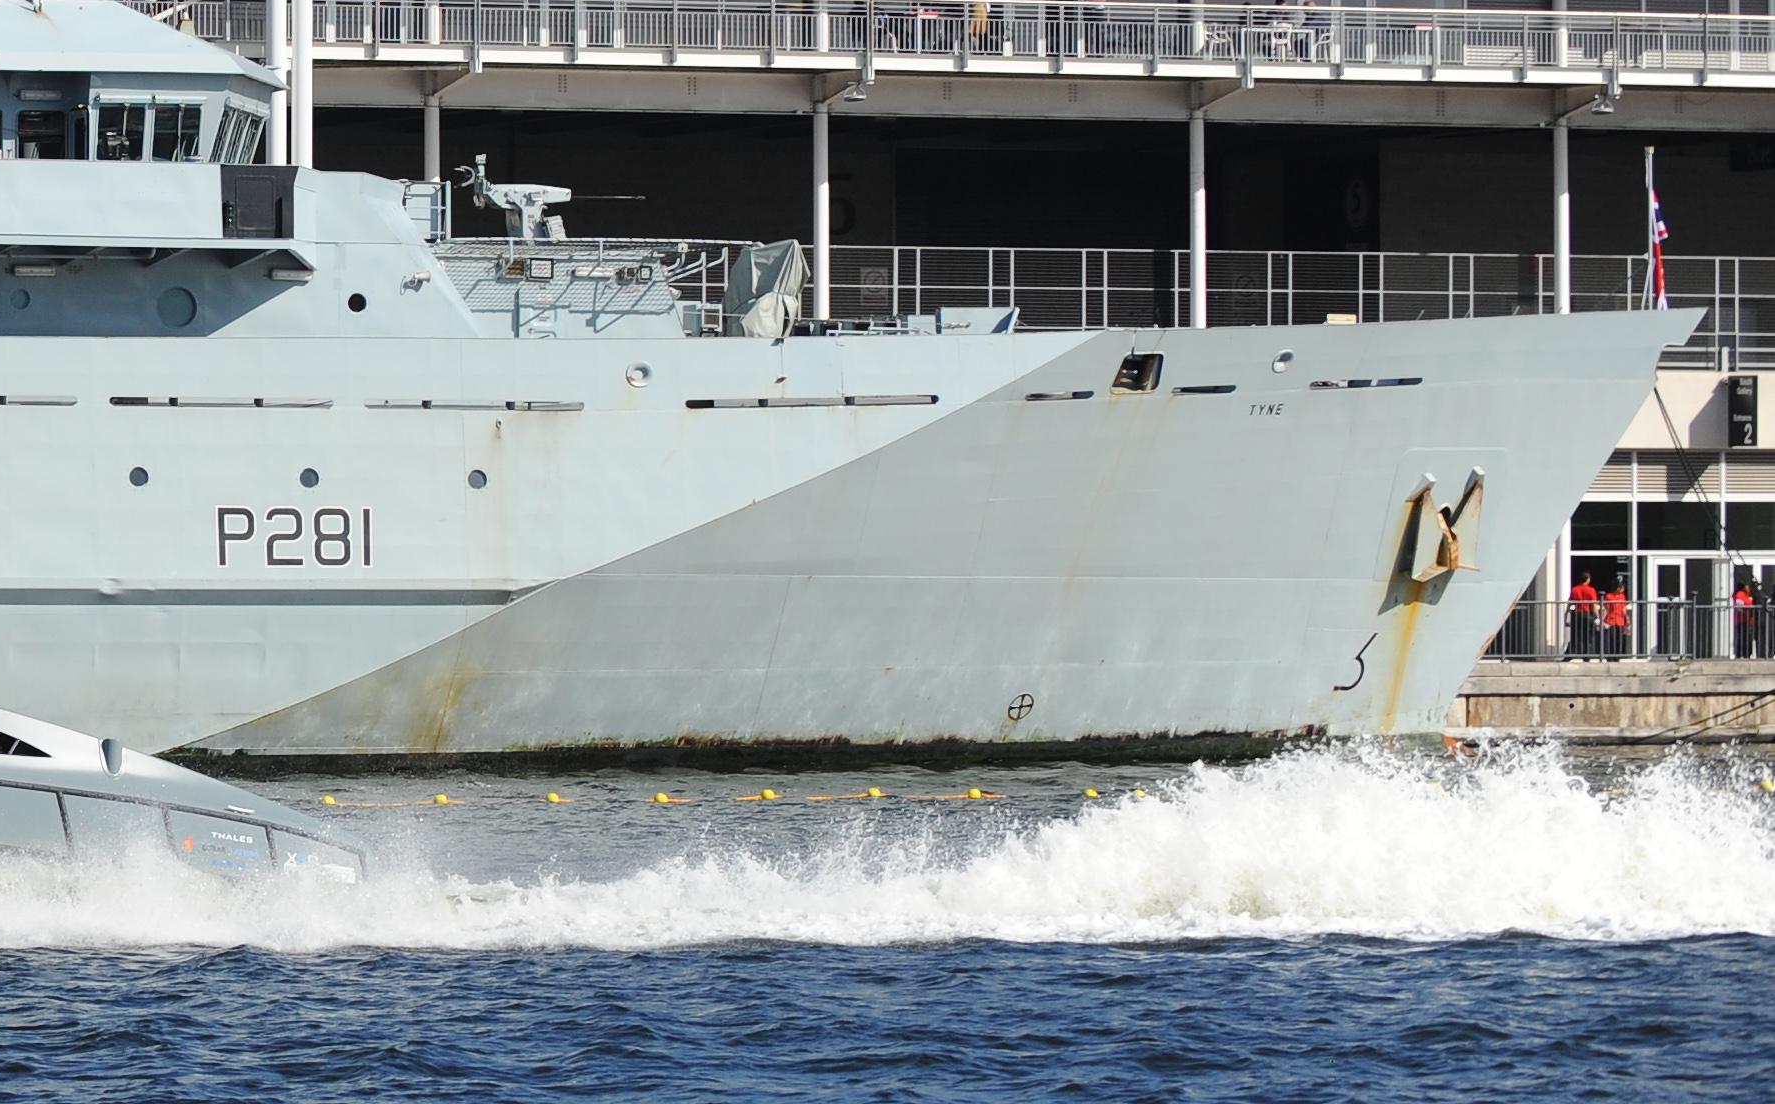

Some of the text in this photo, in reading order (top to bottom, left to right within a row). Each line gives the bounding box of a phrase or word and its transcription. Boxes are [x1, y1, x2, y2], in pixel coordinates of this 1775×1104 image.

[1249, 403, 1284, 416] TYNE
[1744, 422, 1753, 445] 2
[216, 505, 373, 568] P281
[211, 831, 254, 844] THALES
